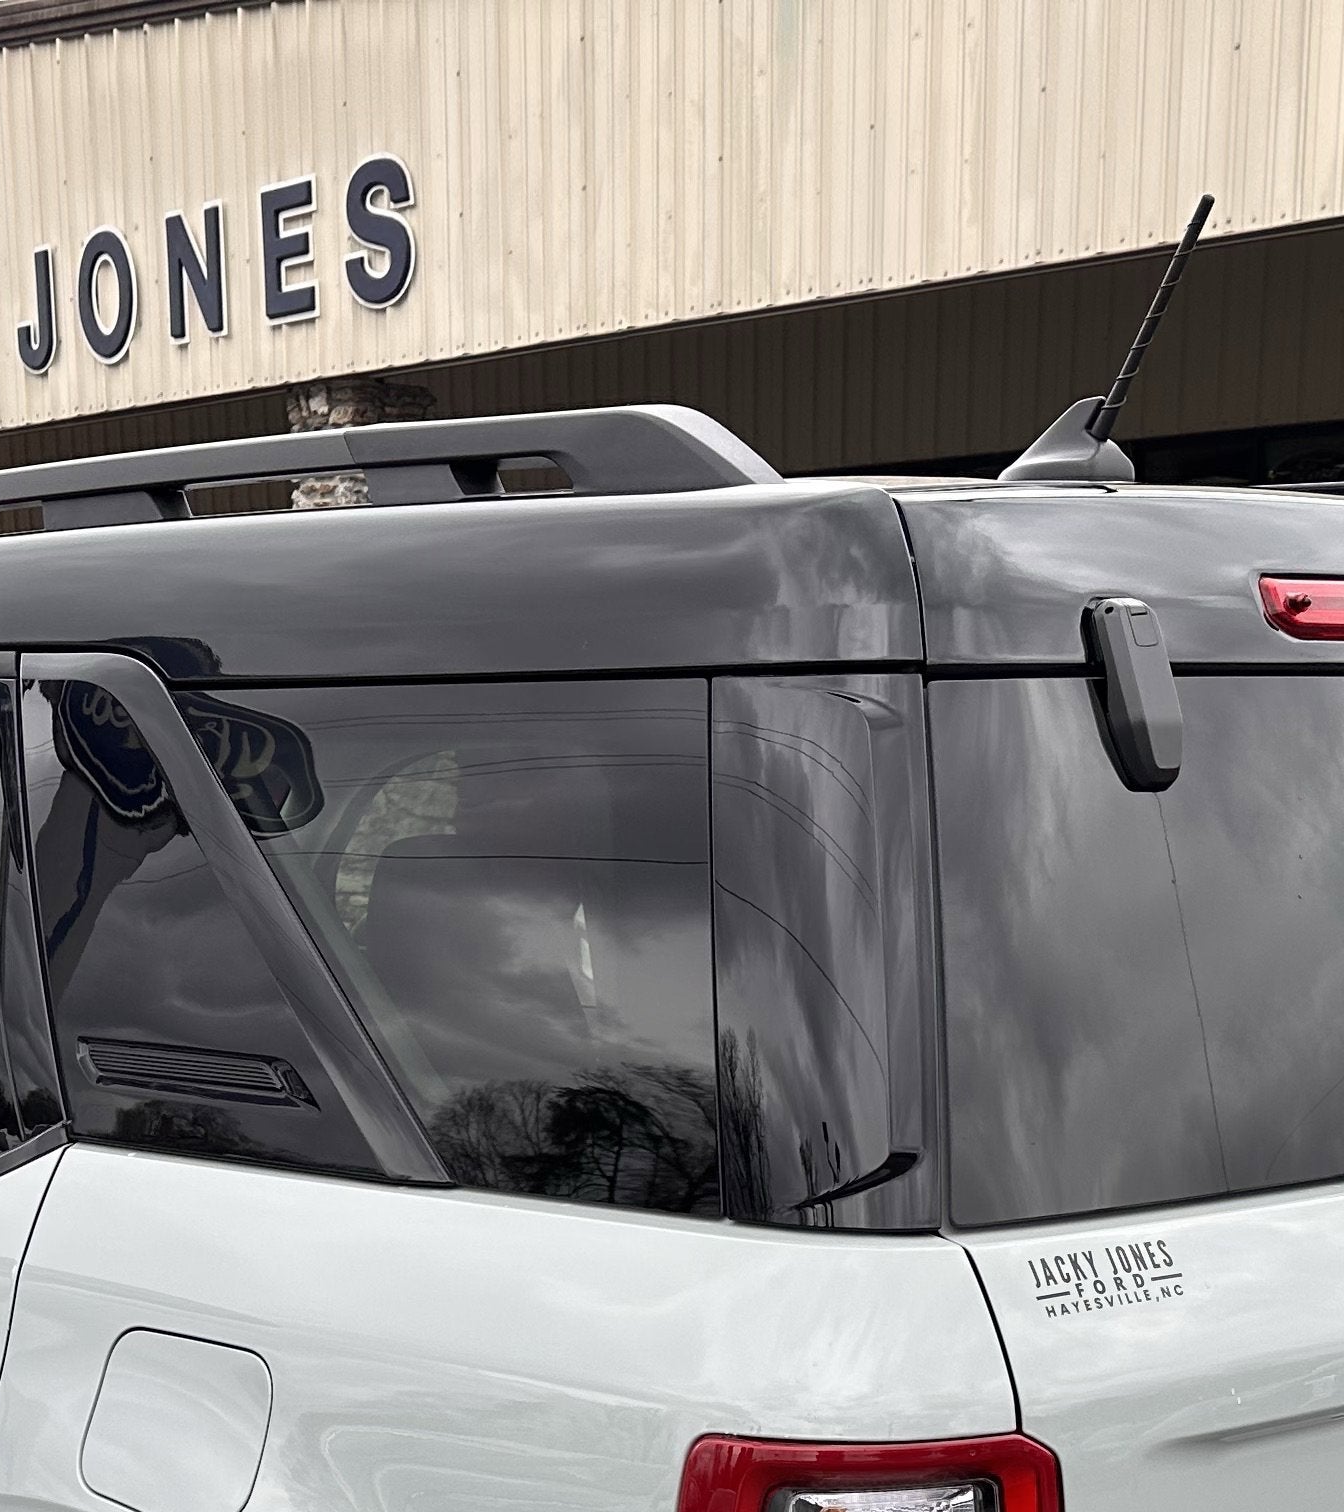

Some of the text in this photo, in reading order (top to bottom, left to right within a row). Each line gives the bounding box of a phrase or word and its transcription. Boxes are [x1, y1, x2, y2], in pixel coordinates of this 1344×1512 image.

[16, 155, 416, 375] JONES
[1028, 1239, 1174, 1289] JACKY JONES
[1074, 1273, 1146, 1298] FORD
